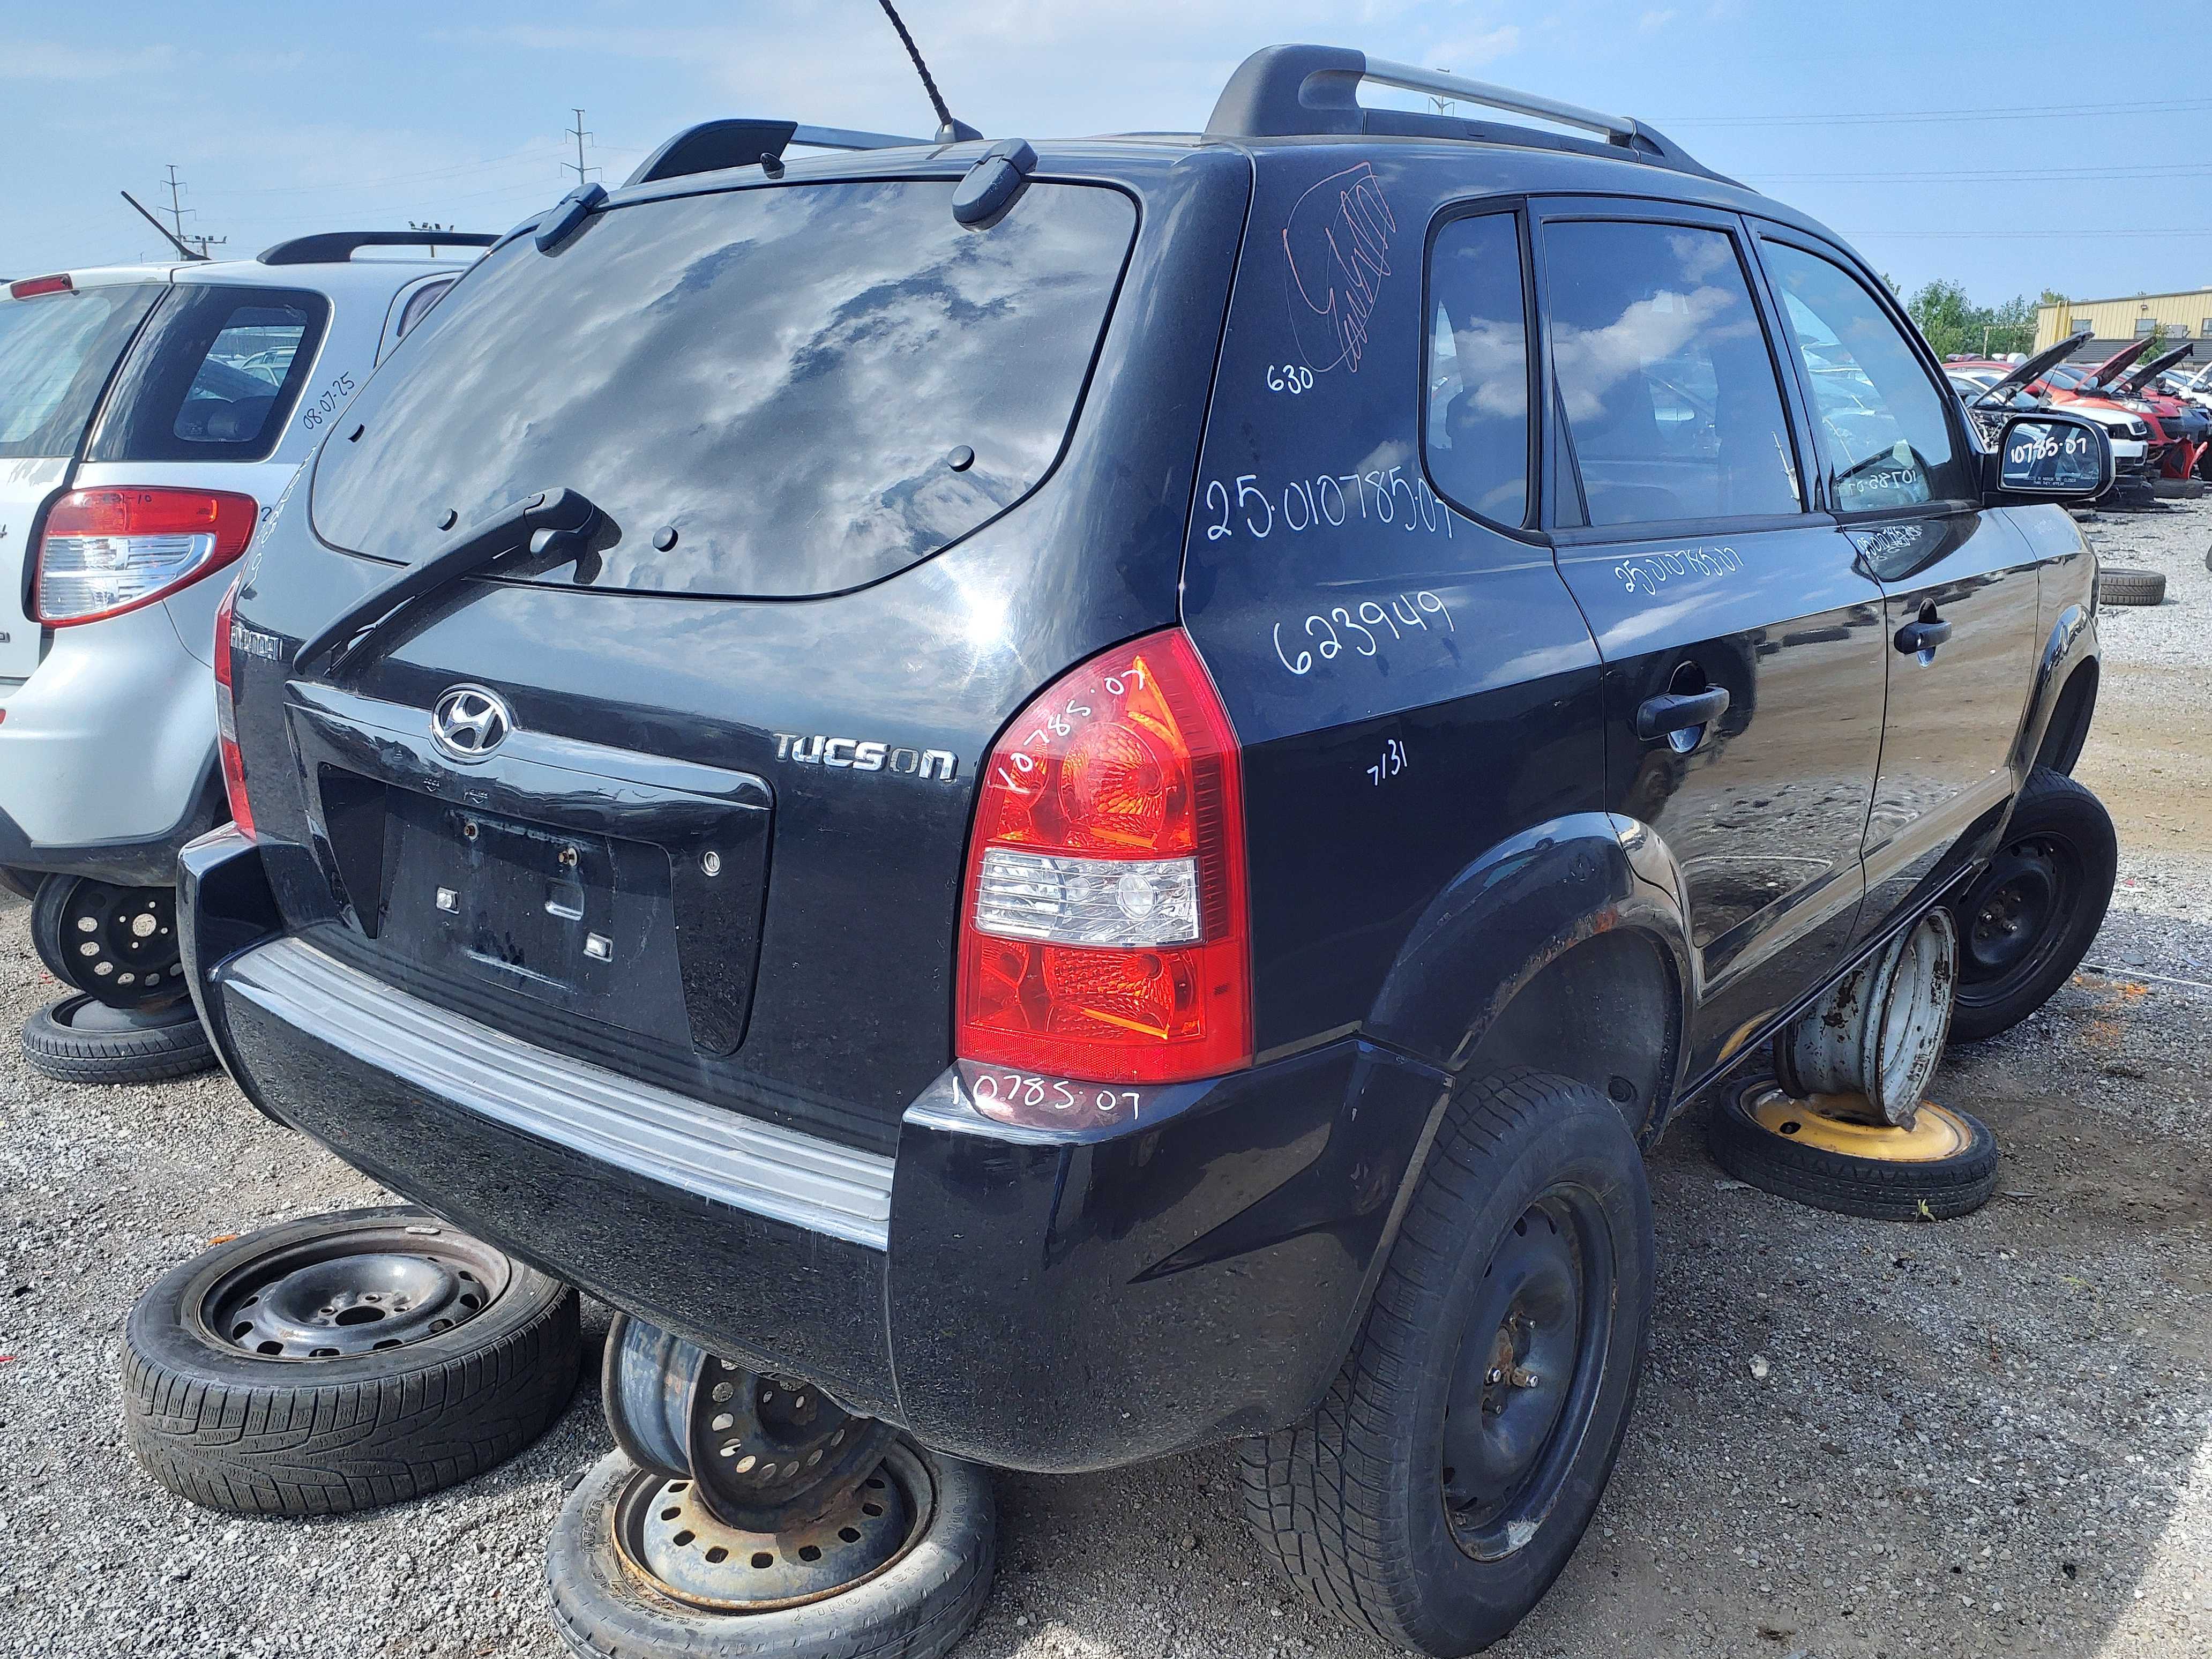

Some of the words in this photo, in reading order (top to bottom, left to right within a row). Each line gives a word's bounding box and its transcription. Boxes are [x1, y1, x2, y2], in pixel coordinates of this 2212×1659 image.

[1267, 364, 1314, 395] 630
[1273, 590, 1455, 675] 623949
[773, 732, 959, 781] TUCSON
[582, 1499, 604, 1554] INFLATE
